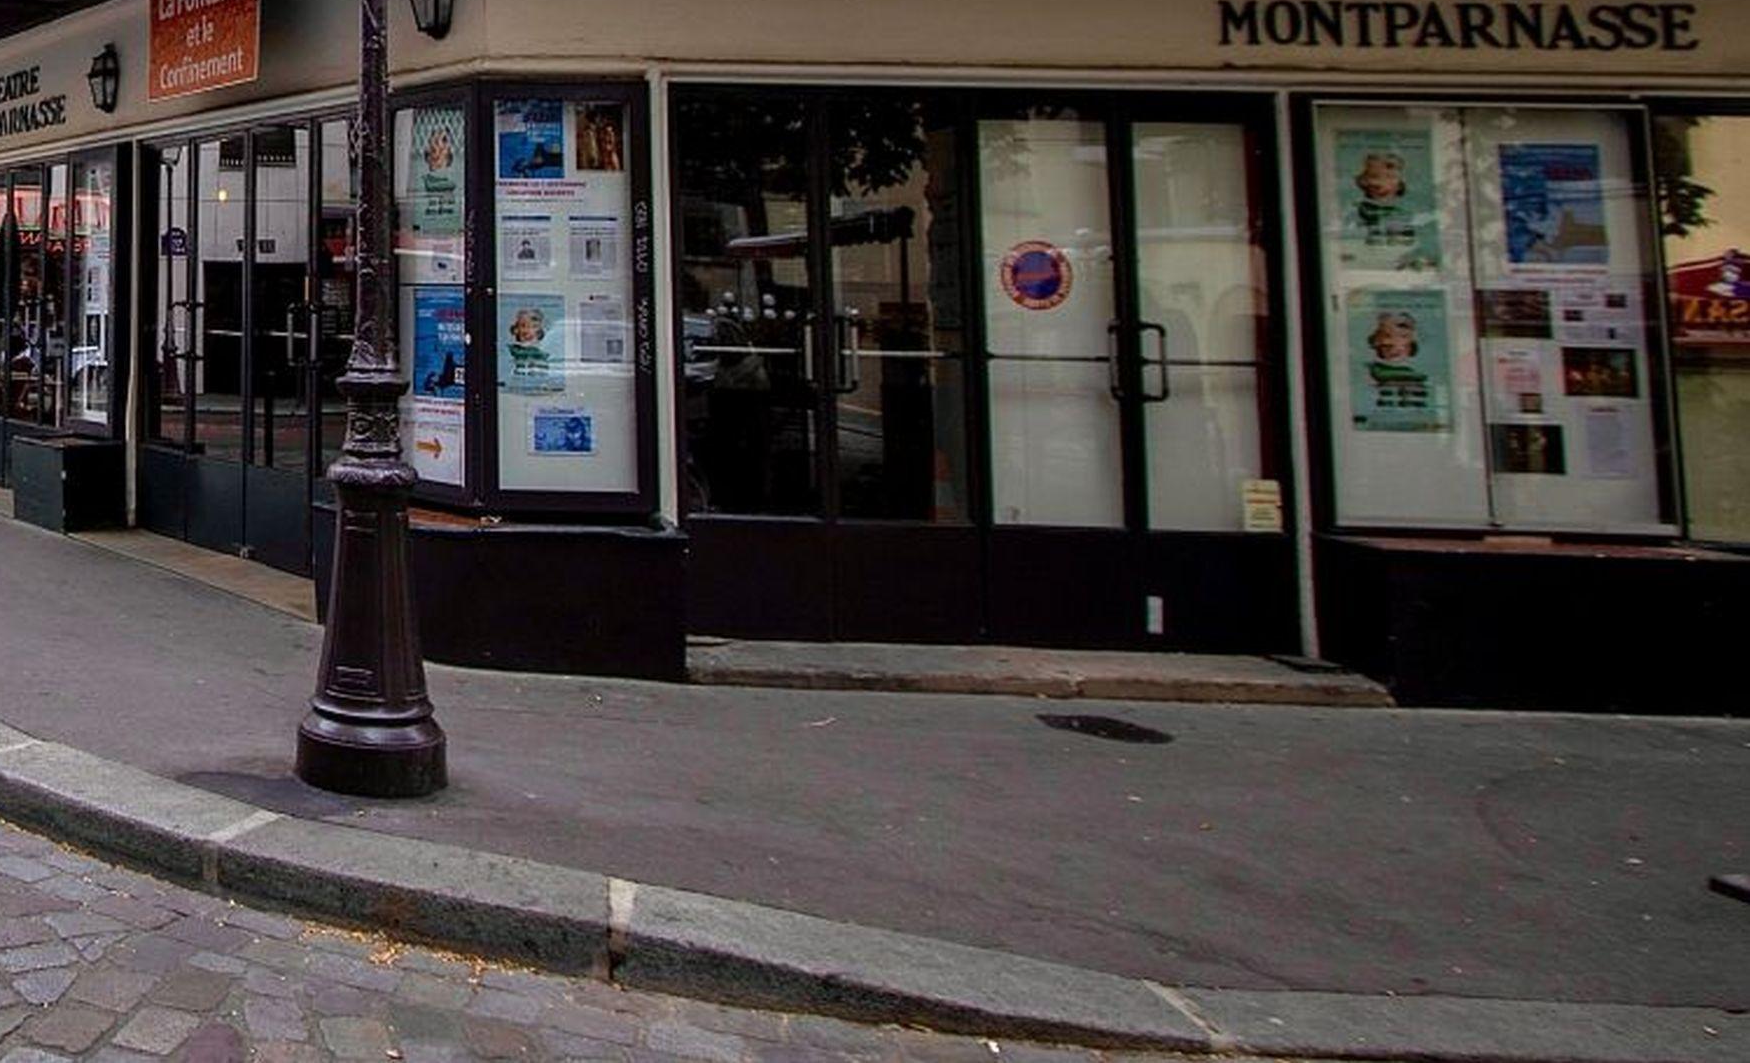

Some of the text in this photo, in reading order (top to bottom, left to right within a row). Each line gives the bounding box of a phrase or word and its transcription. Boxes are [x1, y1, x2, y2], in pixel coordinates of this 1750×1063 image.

[186, 22, 201, 48] et
[1217, 0, 1700, 51] MONTPARNASSE
[159, 45, 245, 89] Confinement
